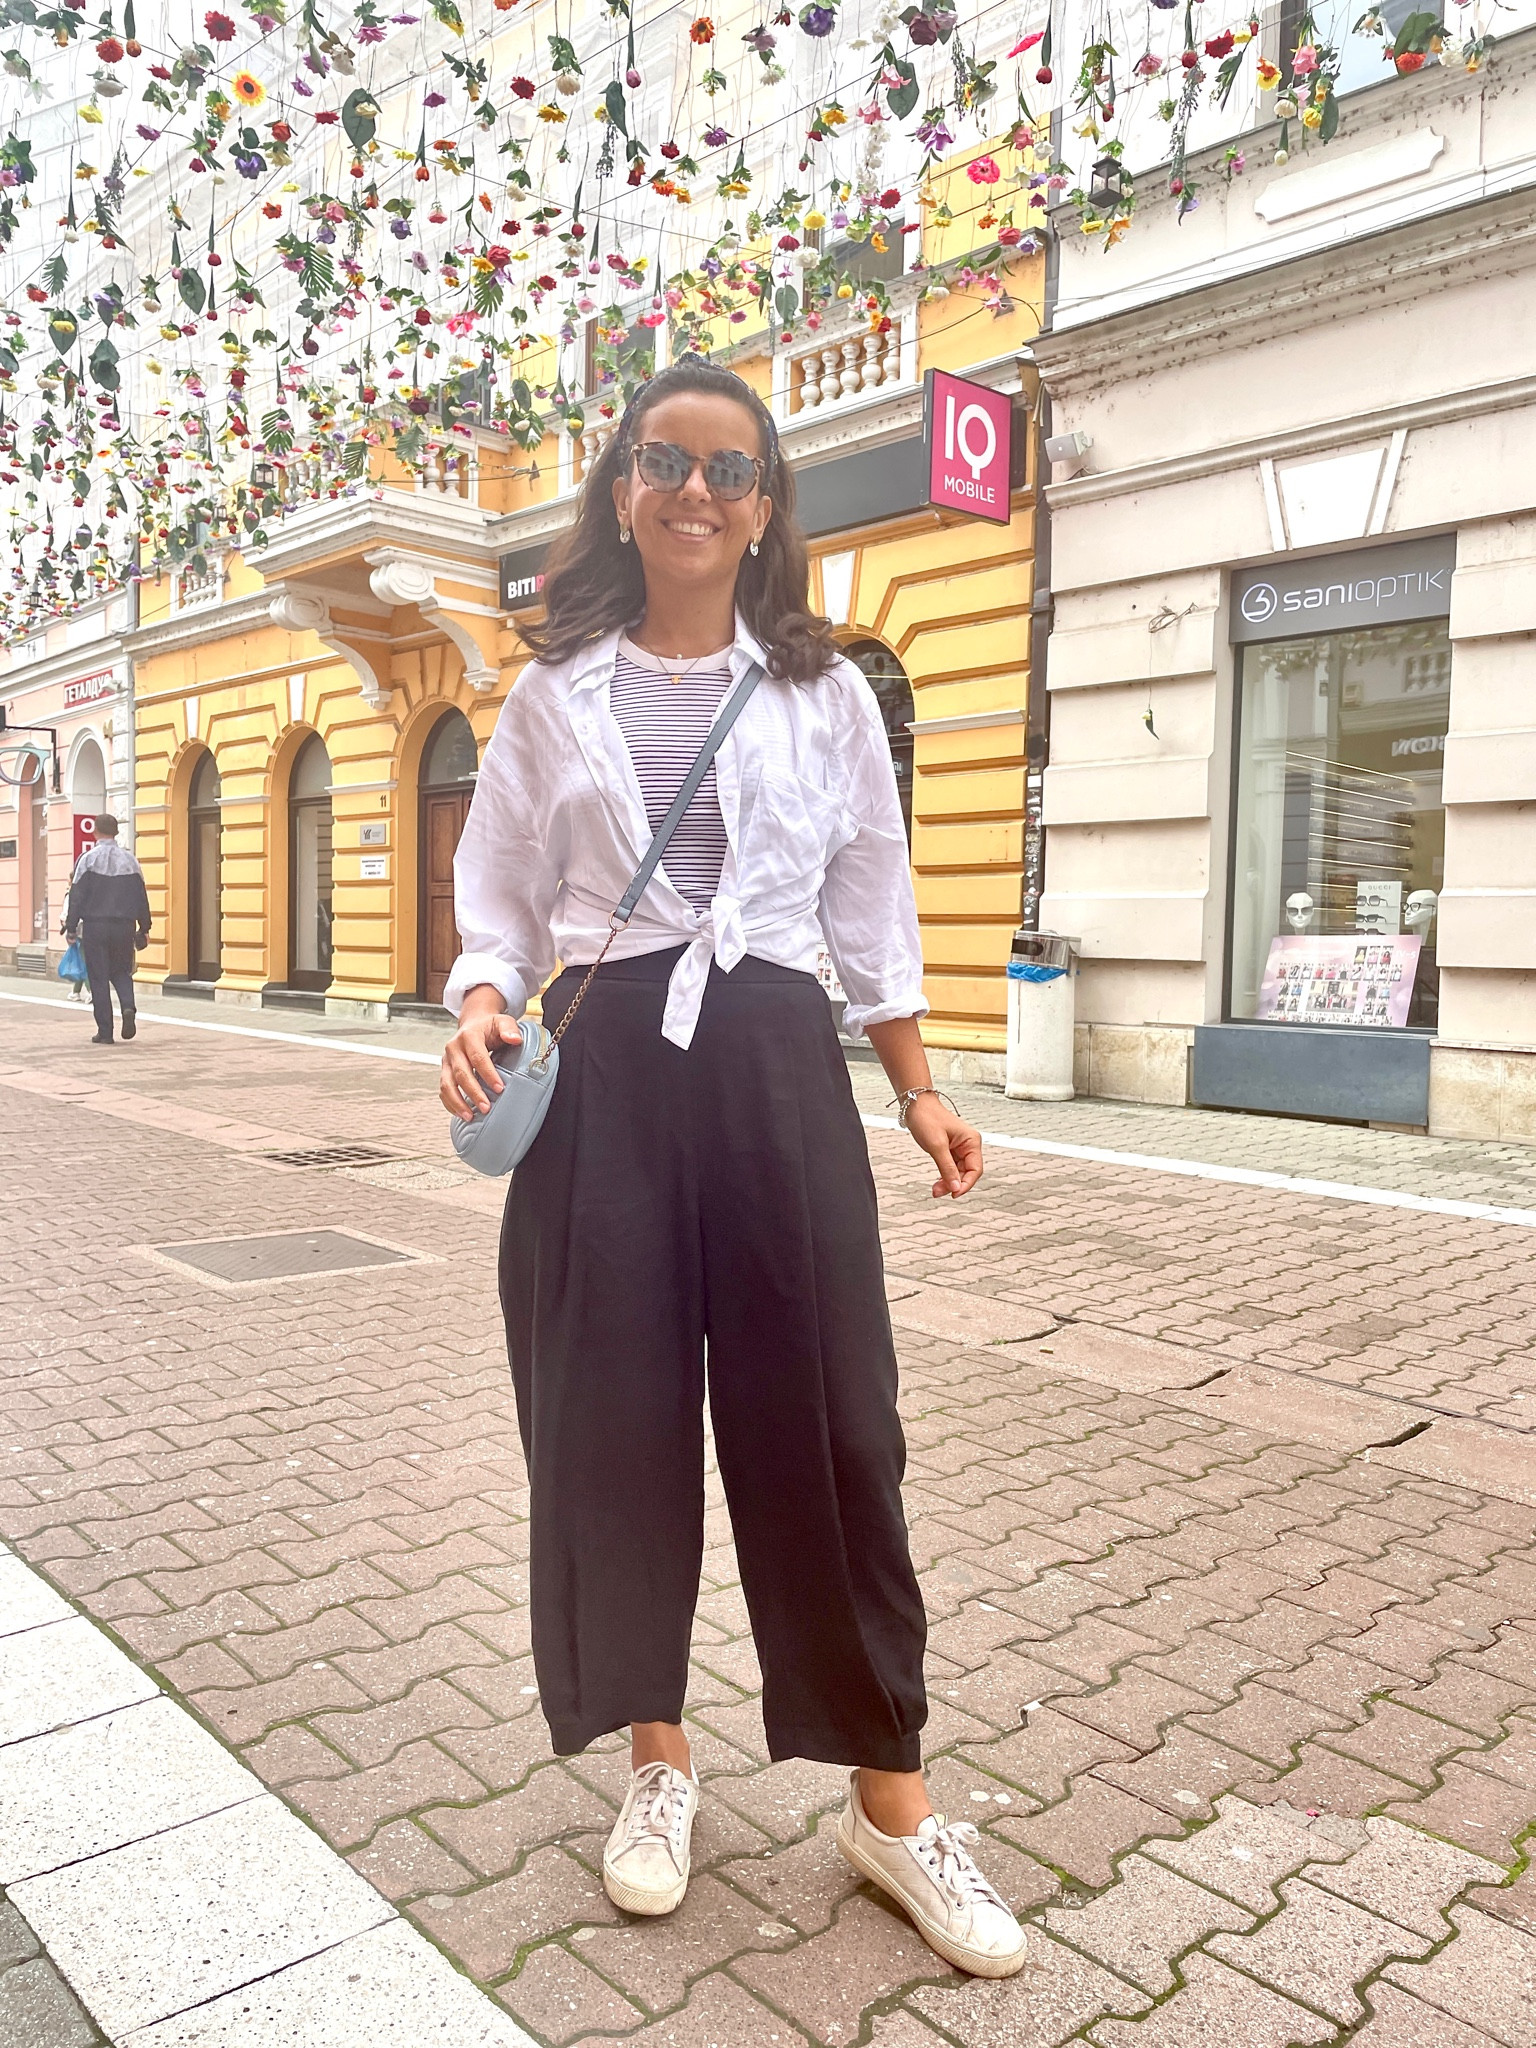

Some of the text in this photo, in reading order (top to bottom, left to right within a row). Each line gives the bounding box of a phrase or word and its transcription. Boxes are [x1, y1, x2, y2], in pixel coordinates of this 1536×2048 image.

[945, 395, 996, 481] IQ
[944, 474, 996, 504] MOBILE
[380, 794, 387, 808] 11
